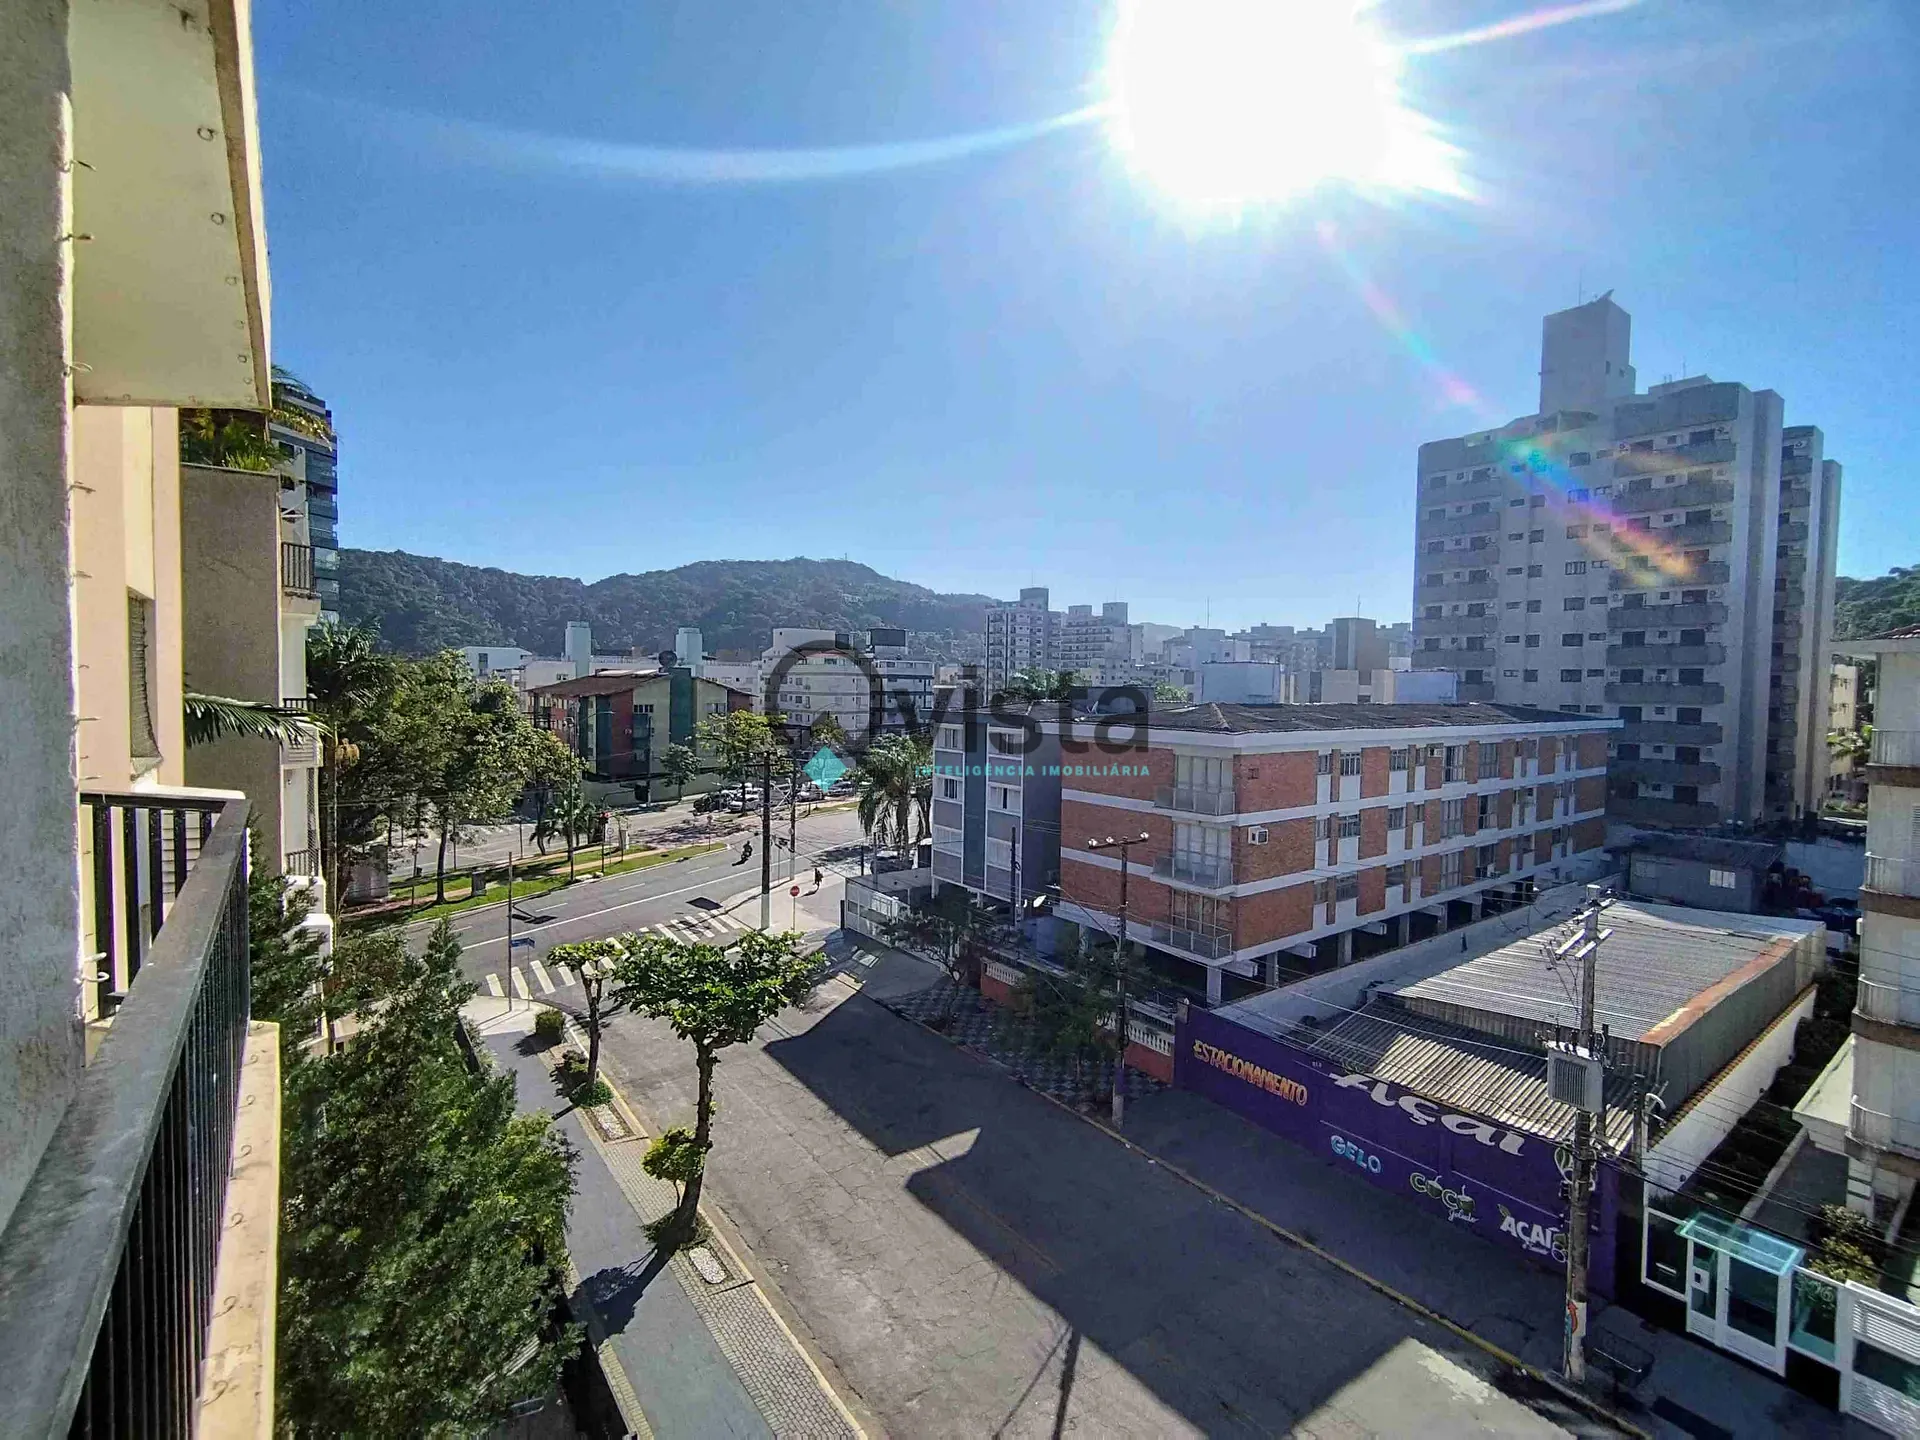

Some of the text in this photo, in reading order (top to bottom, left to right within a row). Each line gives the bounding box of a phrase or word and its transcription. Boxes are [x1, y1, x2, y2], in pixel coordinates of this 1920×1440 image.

[1193, 1039, 1308, 1106] ESTACIONAMENTO
[1330, 1135, 1382, 1174] GELO
[1500, 1215, 1560, 1249] AÇAÍ
